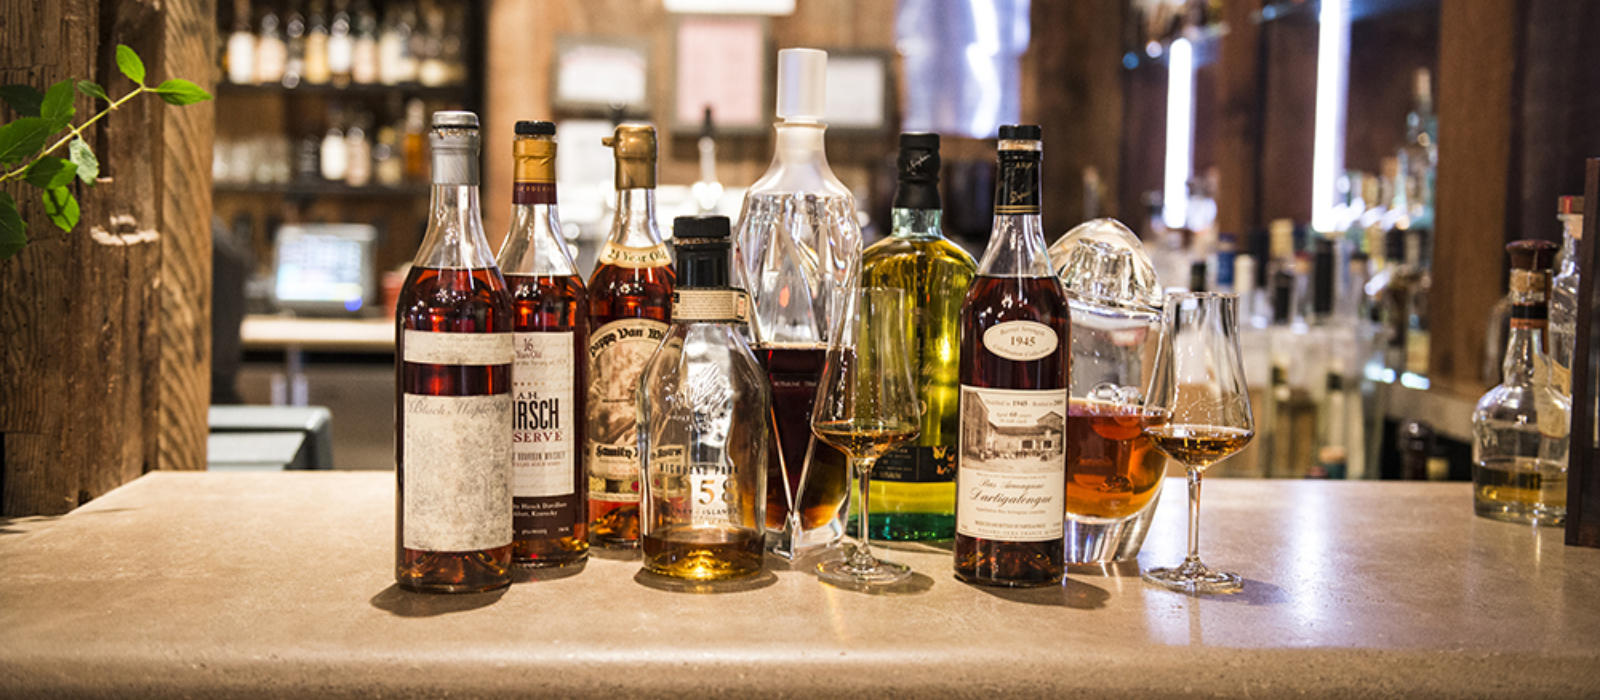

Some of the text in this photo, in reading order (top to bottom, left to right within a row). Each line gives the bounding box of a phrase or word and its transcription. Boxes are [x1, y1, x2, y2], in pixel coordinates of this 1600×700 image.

[617, 327, 643, 339] Van
[523, 337, 534, 351] 16
[1010, 335, 1036, 347] 1945
[512, 398, 559, 430] IRSCH
[513, 431, 563, 443] SERVE
